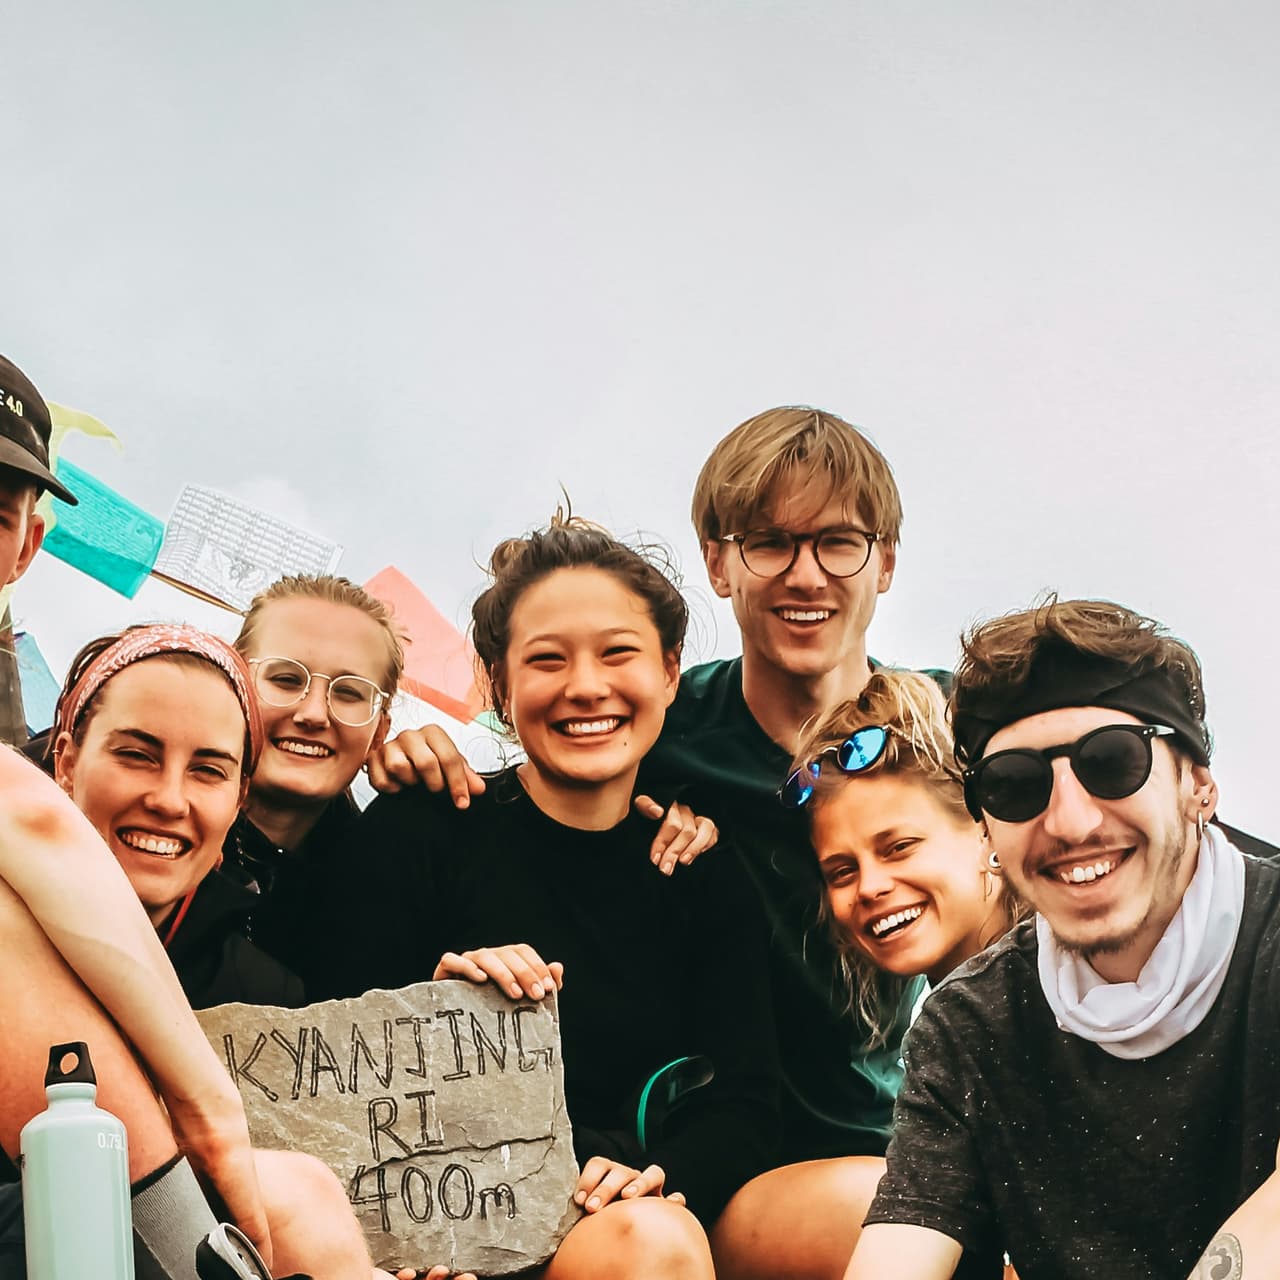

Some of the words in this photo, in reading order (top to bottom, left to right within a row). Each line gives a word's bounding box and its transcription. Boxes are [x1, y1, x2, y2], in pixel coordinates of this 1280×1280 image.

[6, 395, 23, 417] 4.0
[223, 1006, 554, 1101] KYANJING
[367, 1090, 444, 1161] RI
[349, 1164, 517, 1232] 400m
